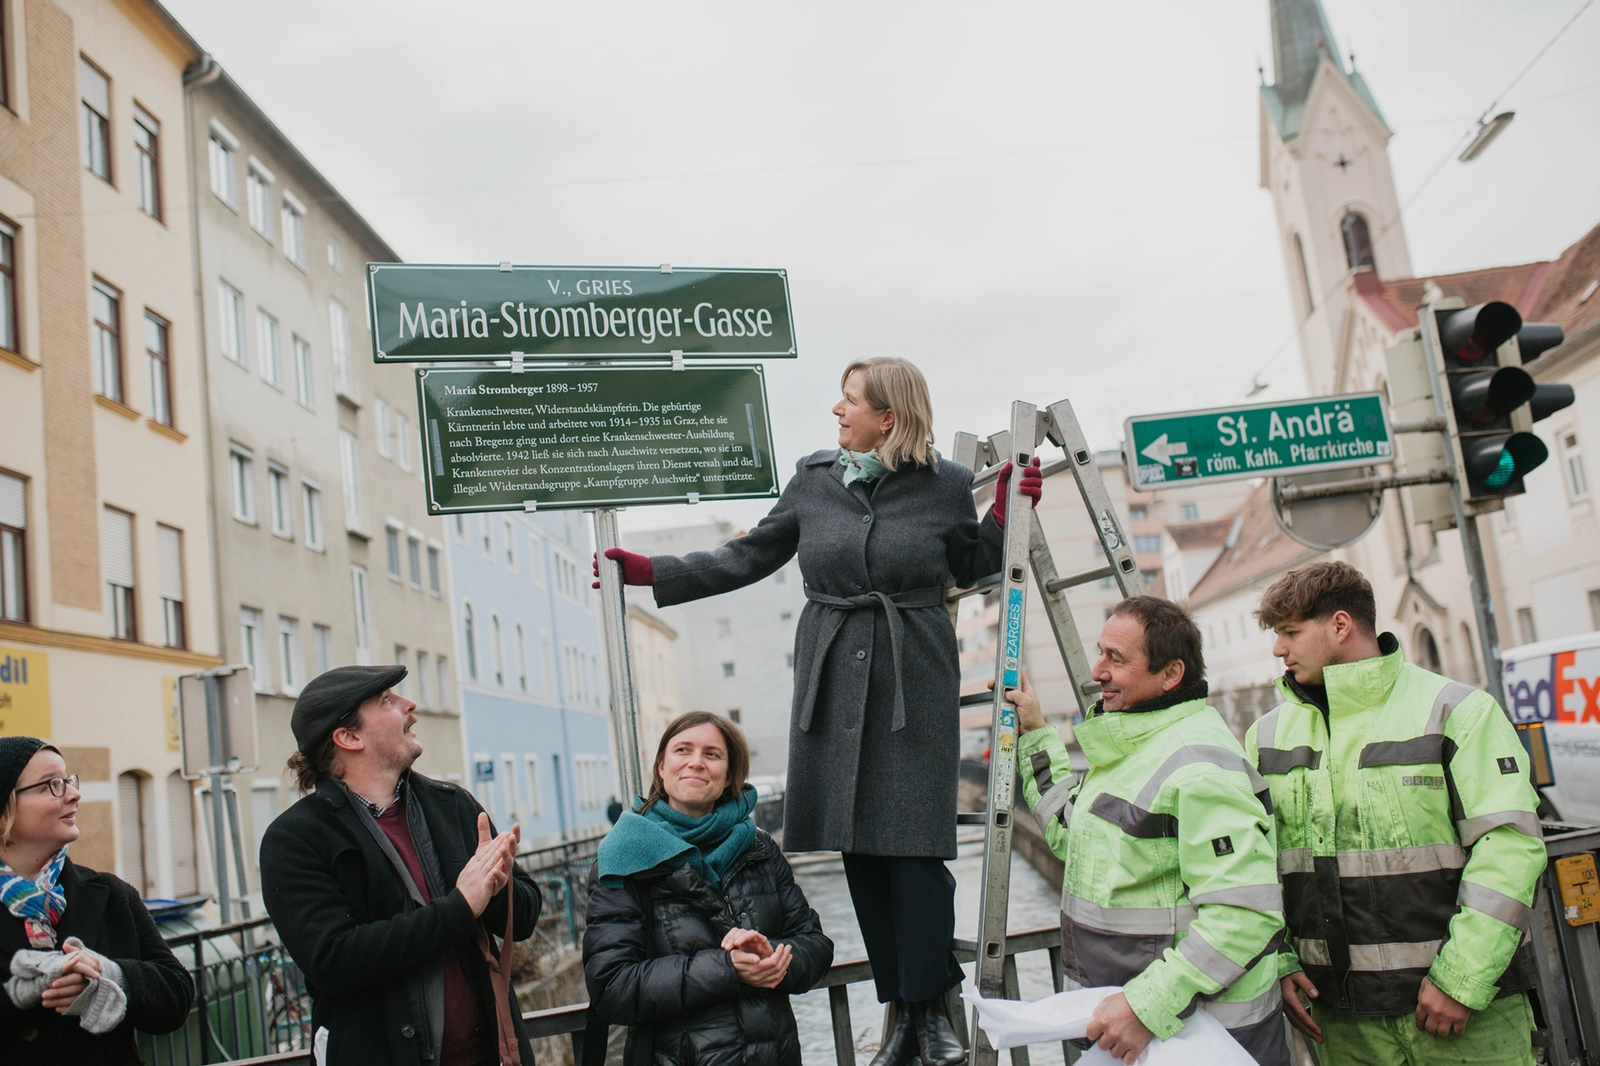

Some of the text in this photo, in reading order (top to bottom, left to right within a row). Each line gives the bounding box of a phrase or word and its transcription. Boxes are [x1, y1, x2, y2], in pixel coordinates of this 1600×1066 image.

[547, 279, 634, 297] V., GRIES
[399, 299, 773, 344] Maria-Stromberger-Gasse
[444, 385, 478, 396] Maria
[478, 383, 544, 397] Stromberger
[445, 401, 702, 418] Krankenschwester, Widerstandskämpferin. Die gebürtige
[447, 415, 728, 433] Kärntnerin lebte und arbeitete von 1914–1935 in Graz, ehe sie
[1216, 403, 1355, 447] St. Andrä
[448, 428, 735, 450] nach Bregenz ging und dort eine Krankenschwester-Ausbildung
[450, 451, 505, 463] absolvierte.
[505, 449, 530, 461] 1942
[531, 448, 550, 460] ließ
[551, 449, 565, 459] sie
[566, 447, 586, 459] sich
[586, 446, 609, 458] nach
[610, 445, 659, 457] Auschwitz
[659, 446, 703, 455] versetzen,
[717, 443, 730, 453] sie
[730, 443, 744, 453] im
[1206, 453, 1241, 473] röm.
[1245, 448, 1283, 469] Kath.
[1290, 438, 1375, 463] Pfarrkirche
[451, 456, 754, 479] Krankenrevier des Konzentrationslagers ihren Dienst versah und die
[452, 482, 488, 496] illegale
[488, 479, 582, 493] Widerstandsgruppe
[702, 471, 756, 483] unterstützte.
[1006, 603, 1021, 656] ZARGES
[1403, 776, 1444, 786] GRAZ
[1582, 898, 1593, 908] 24
